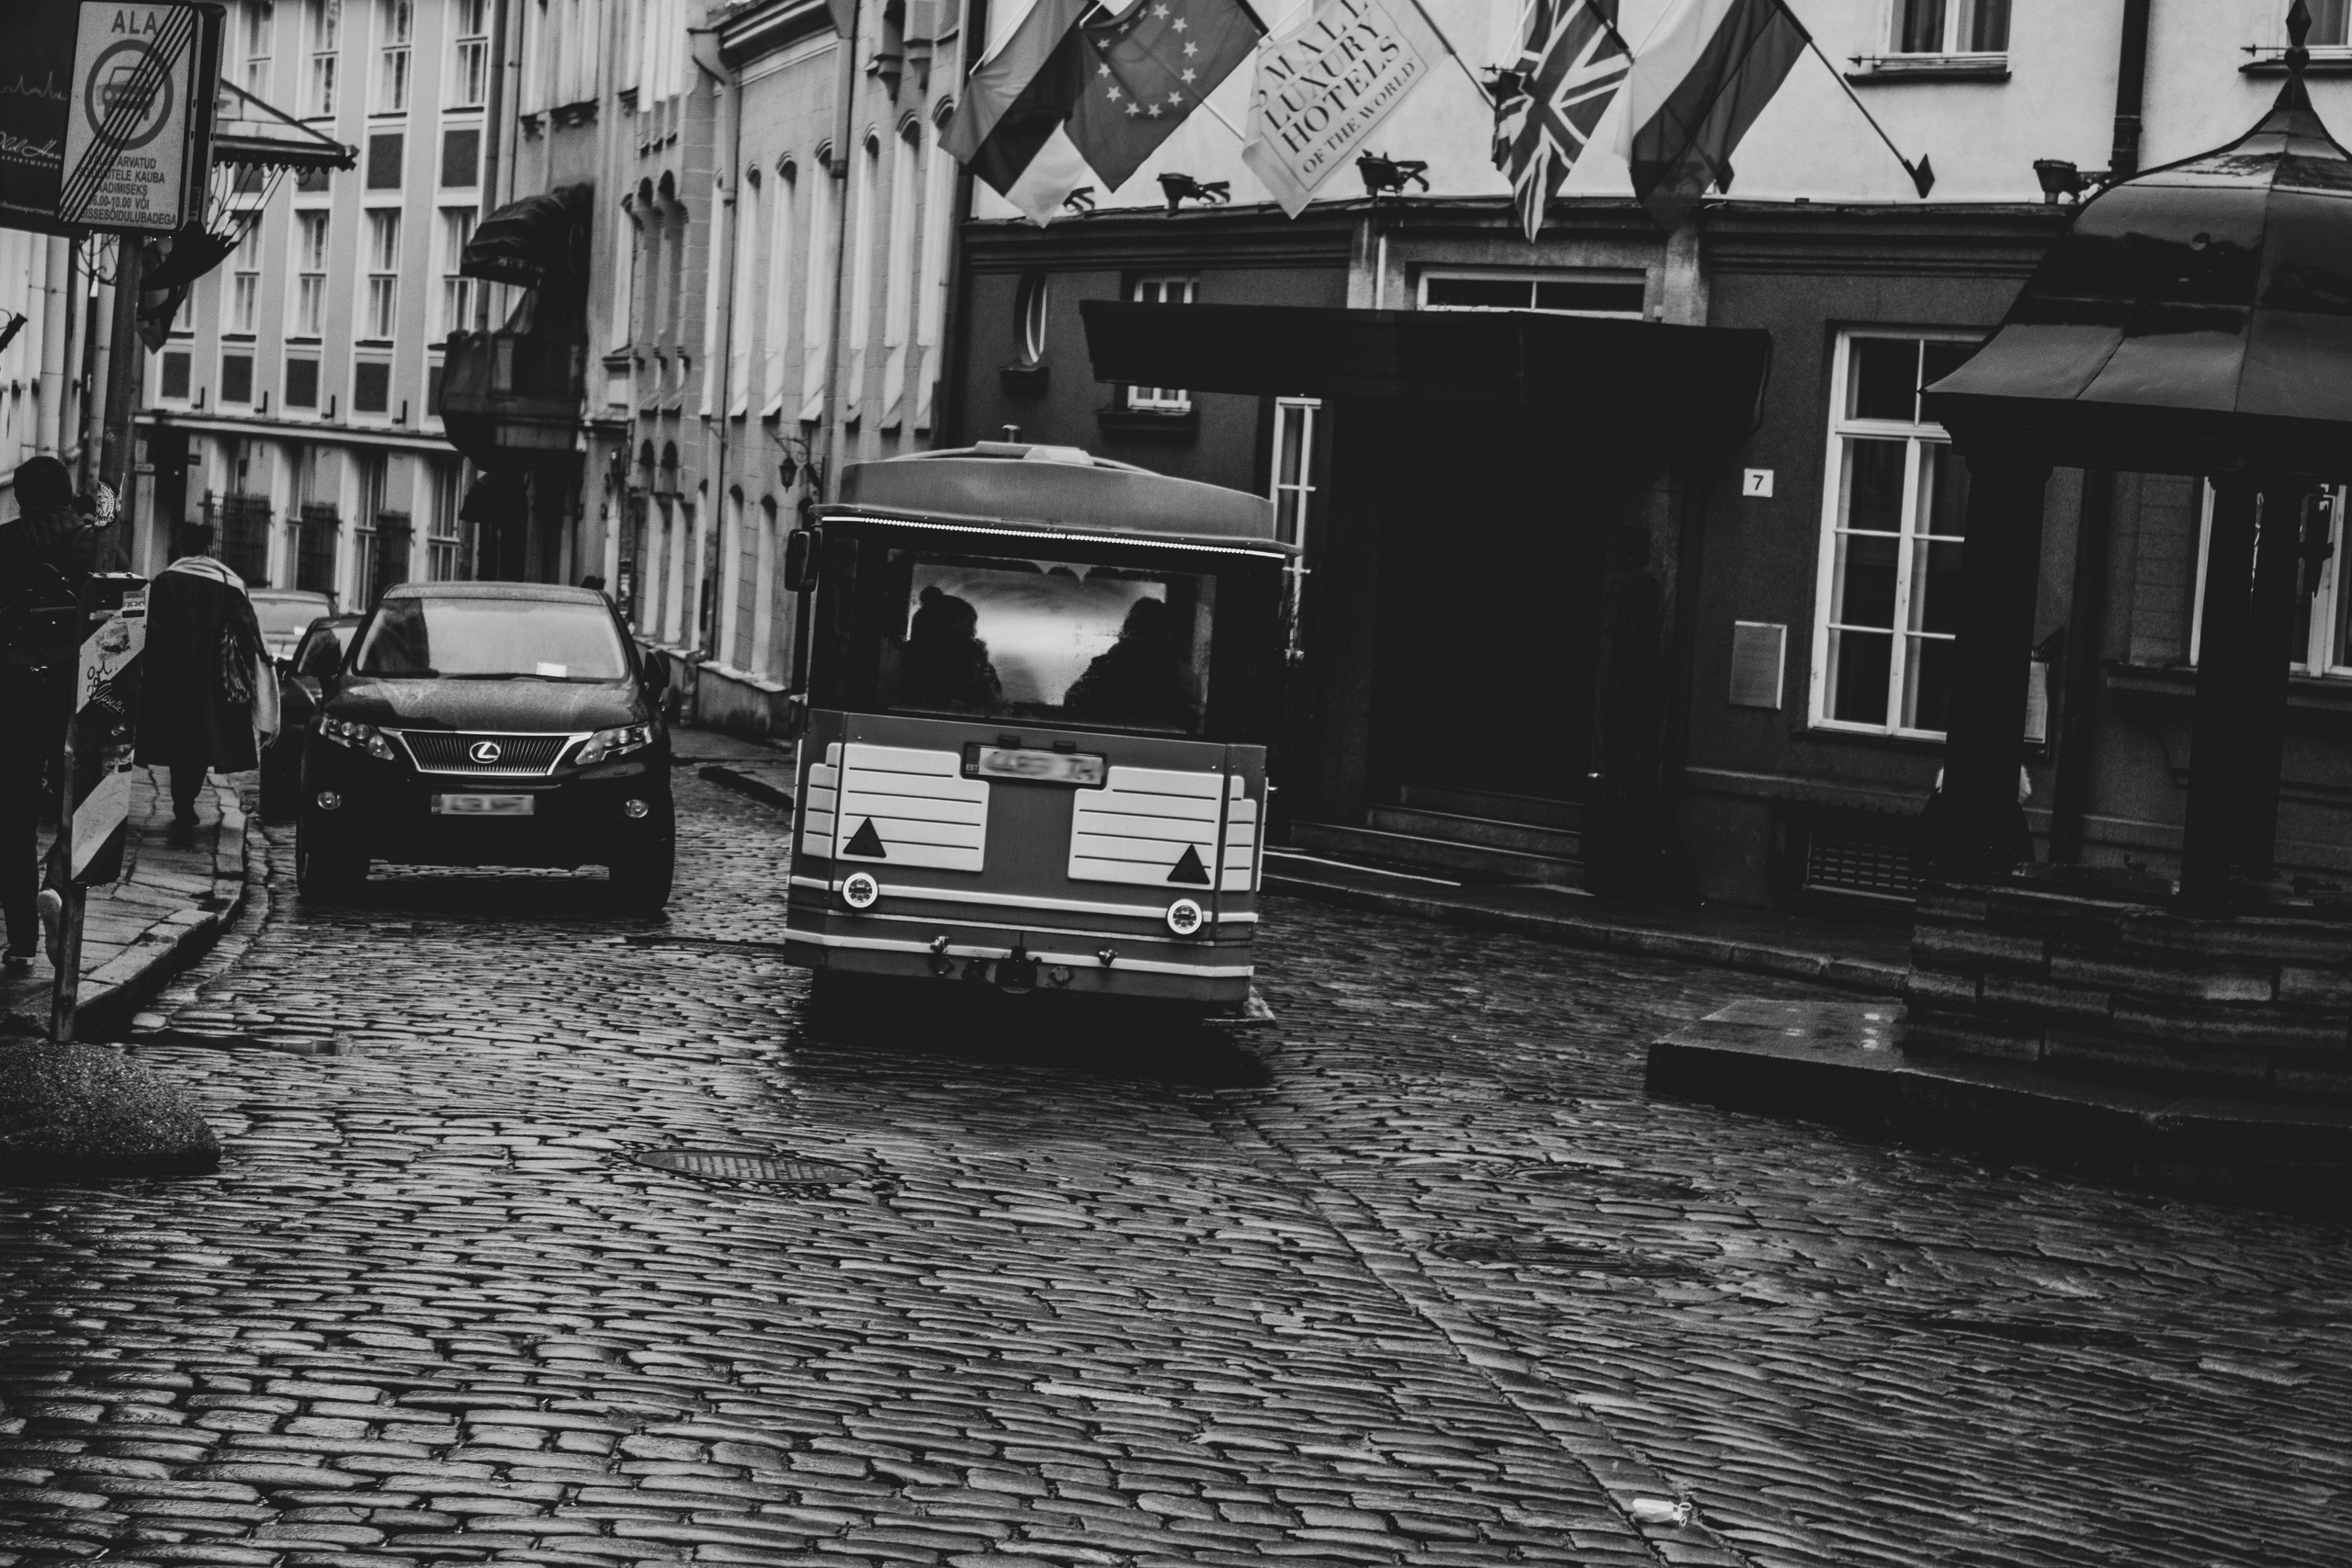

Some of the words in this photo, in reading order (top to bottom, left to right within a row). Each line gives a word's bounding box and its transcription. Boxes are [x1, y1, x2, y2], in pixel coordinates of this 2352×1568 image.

[110, 9, 158, 35] ALA
[1263, 13, 1380, 131] LUXURY
[1281, 35, 1401, 154] HOTELS
[1302, 148, 1326, 175] OF
[1324, 117, 1362, 152] THE
[1359, 60, 1416, 120] WORLD
[117, 155, 157, 170] ARVATUD
[134, 170, 165, 184] KAUBA
[134, 196, 150, 210] VÕI
[1752, 474, 1764, 491] 7
[965, 763, 979, 772] EST
